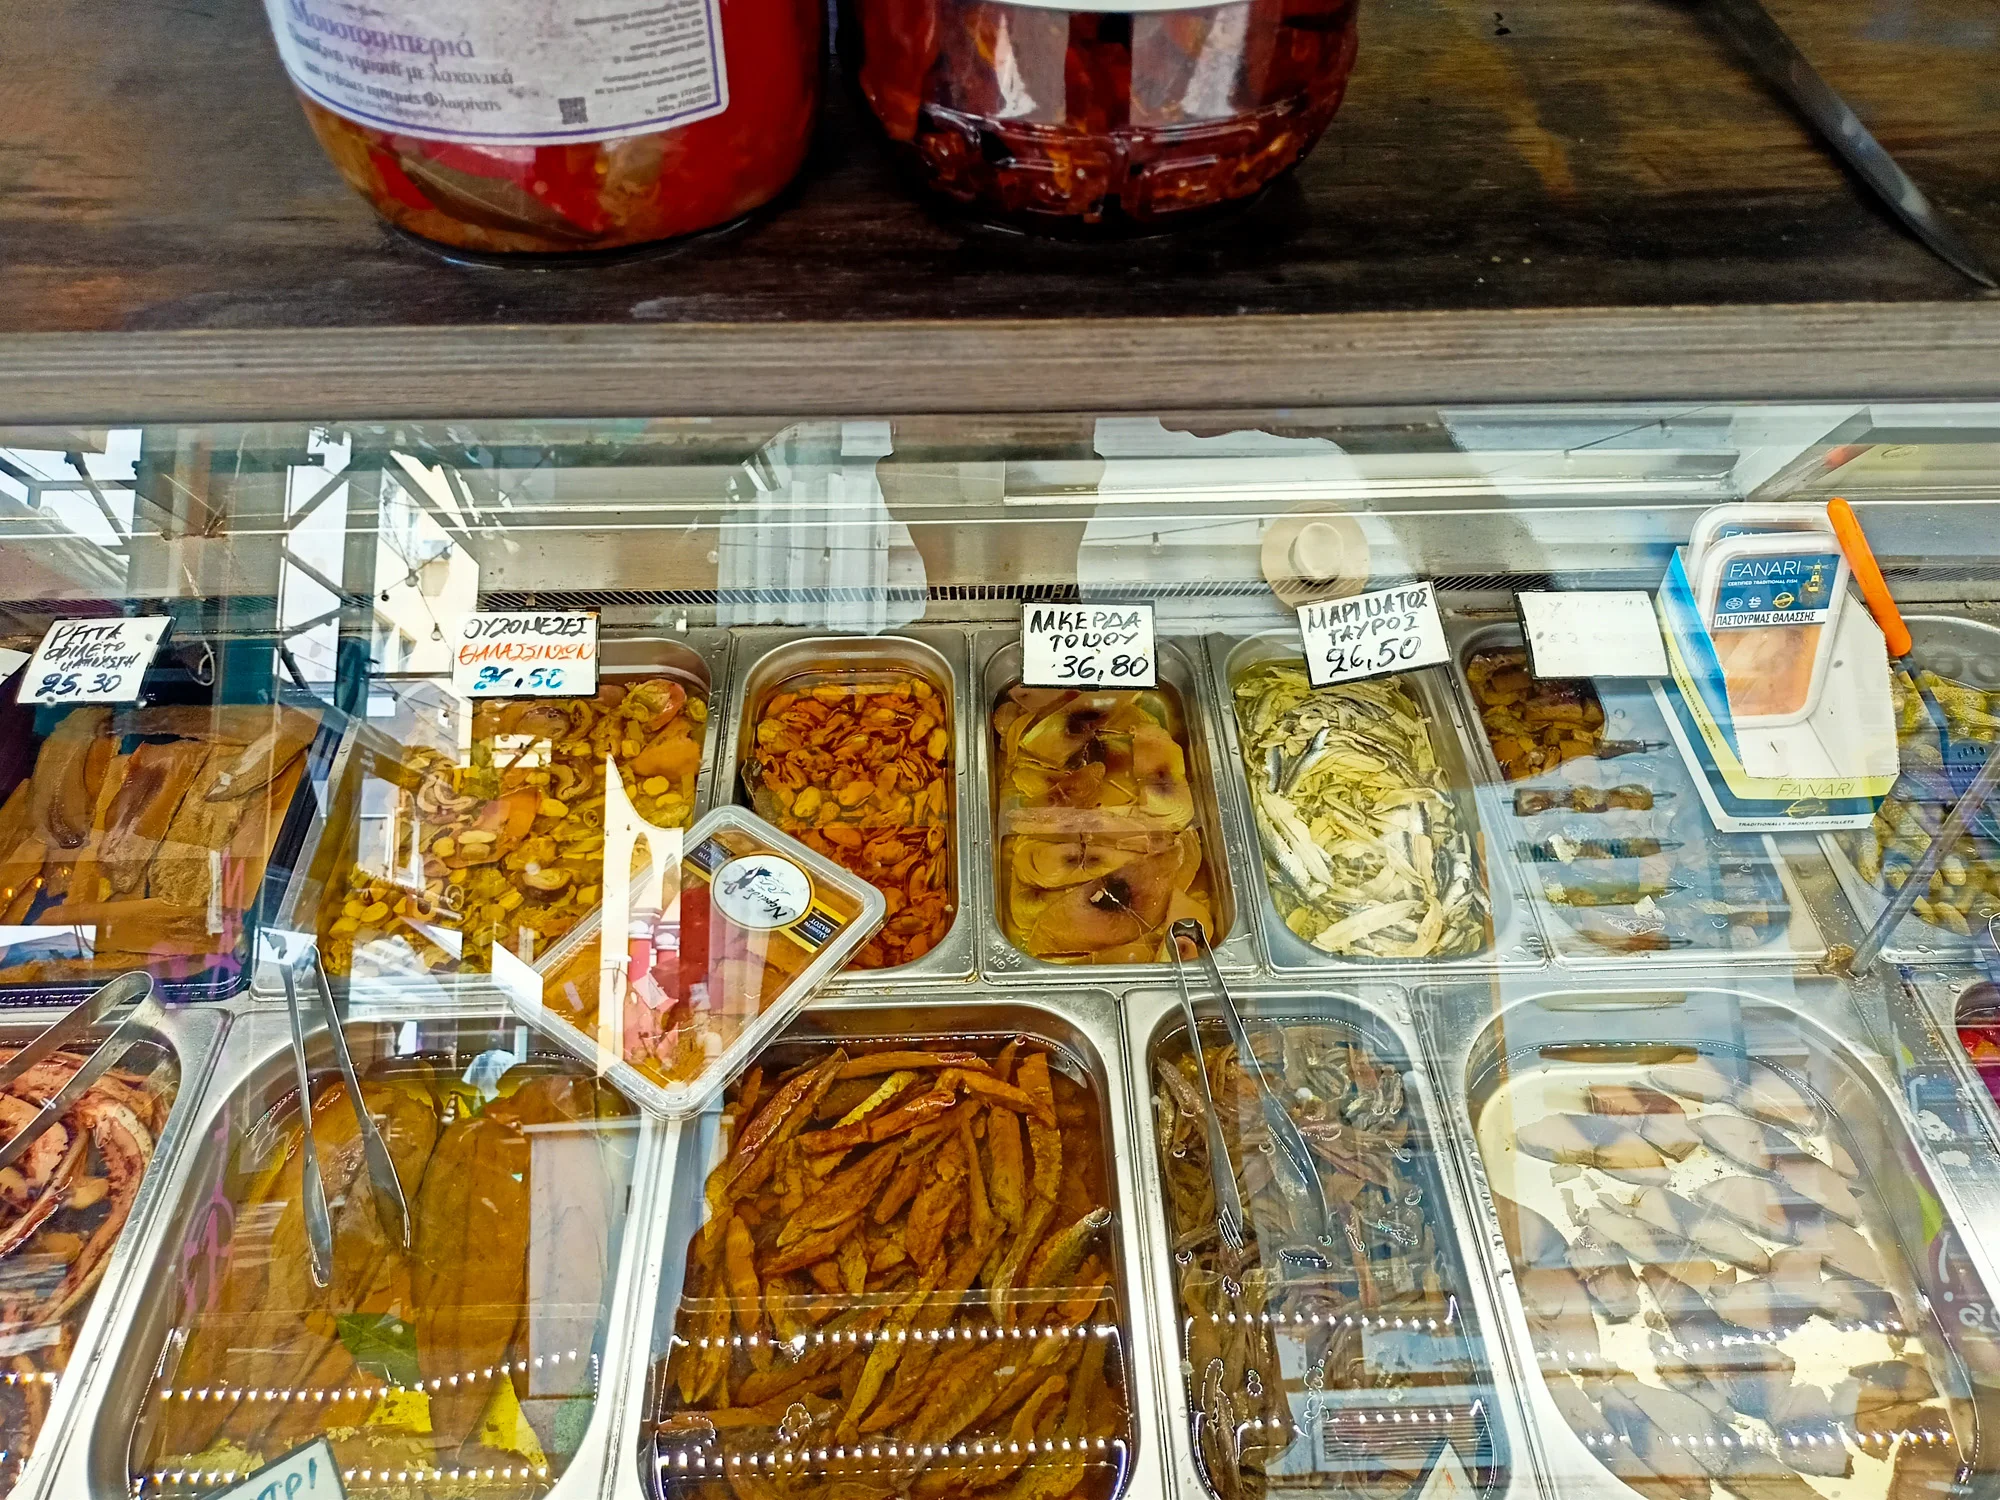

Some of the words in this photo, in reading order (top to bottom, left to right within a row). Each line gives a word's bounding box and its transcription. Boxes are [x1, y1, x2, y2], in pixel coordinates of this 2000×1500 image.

[432, 62, 514, 84] λαχανικά
[1730, 561, 1801, 578] FANARI
[1030, 610, 1141, 633] ΛΑΚΕΡΔΑ
[1308, 588, 1428, 633] ΜΑΡΙΝΑΤΟΣ
[1716, 613, 1771, 626] ΠΑΣΤΟΥΡΜΑΣ
[1772, 611, 1816, 622] ΘΑΛΑΣΣΗΣ
[1328, 612, 1419, 646] ΓΑΥΡΟΣ
[1049, 632, 1139, 652] ΤΟΝΟΥ
[1058, 654, 1149, 681] 36,80
[1326, 636, 1422, 678] 26,50
[1776, 782, 1855, 797] FANARI
